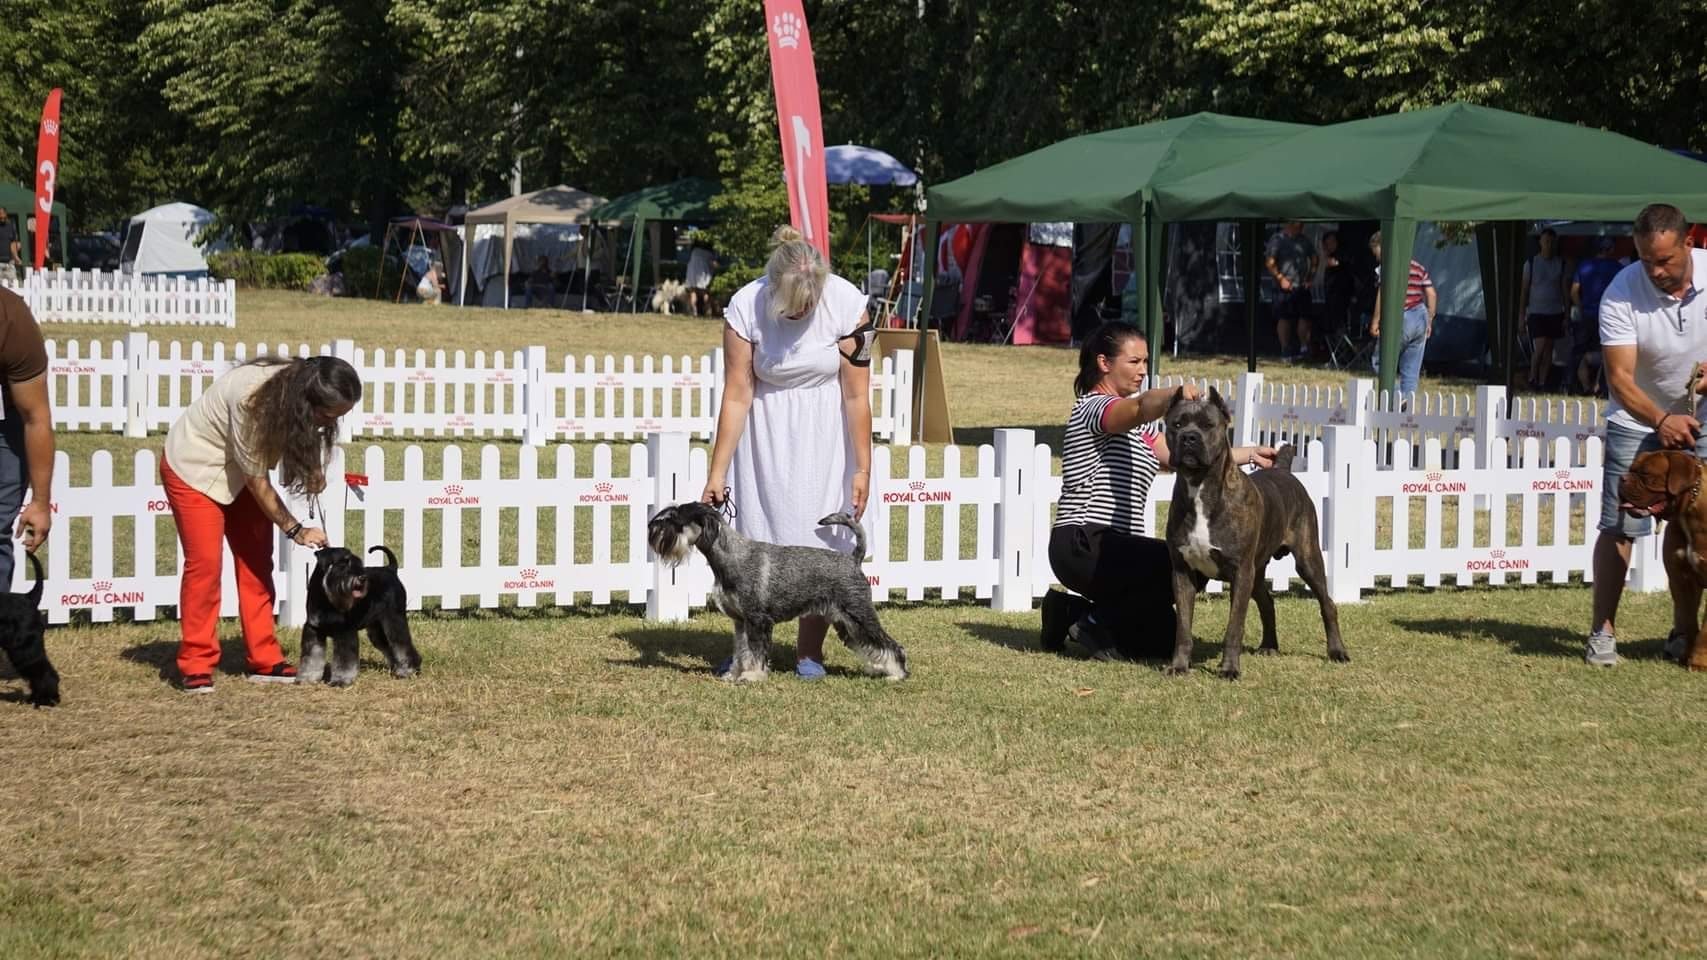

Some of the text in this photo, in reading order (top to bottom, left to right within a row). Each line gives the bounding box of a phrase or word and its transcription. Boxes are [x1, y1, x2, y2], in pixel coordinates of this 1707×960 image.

[792, 116, 812, 239] 1
[39, 160, 55, 212] 3
[1402, 482, 1466, 492] ROYAL CANIN
[1532, 480, 1593, 490] ROYAL CANIN
[428, 497, 479, 506] ROYAL CANIN
[580, 495, 603, 503] ROYAL
[883, 491, 951, 503] ROYAL CANIN
[147, 500, 172, 512] ROY
[1466, 560, 1530, 570] ROYAL CANIN
[530, 580, 554, 588] CANIN
[61, 592, 144, 607] ROYAL CANIN
